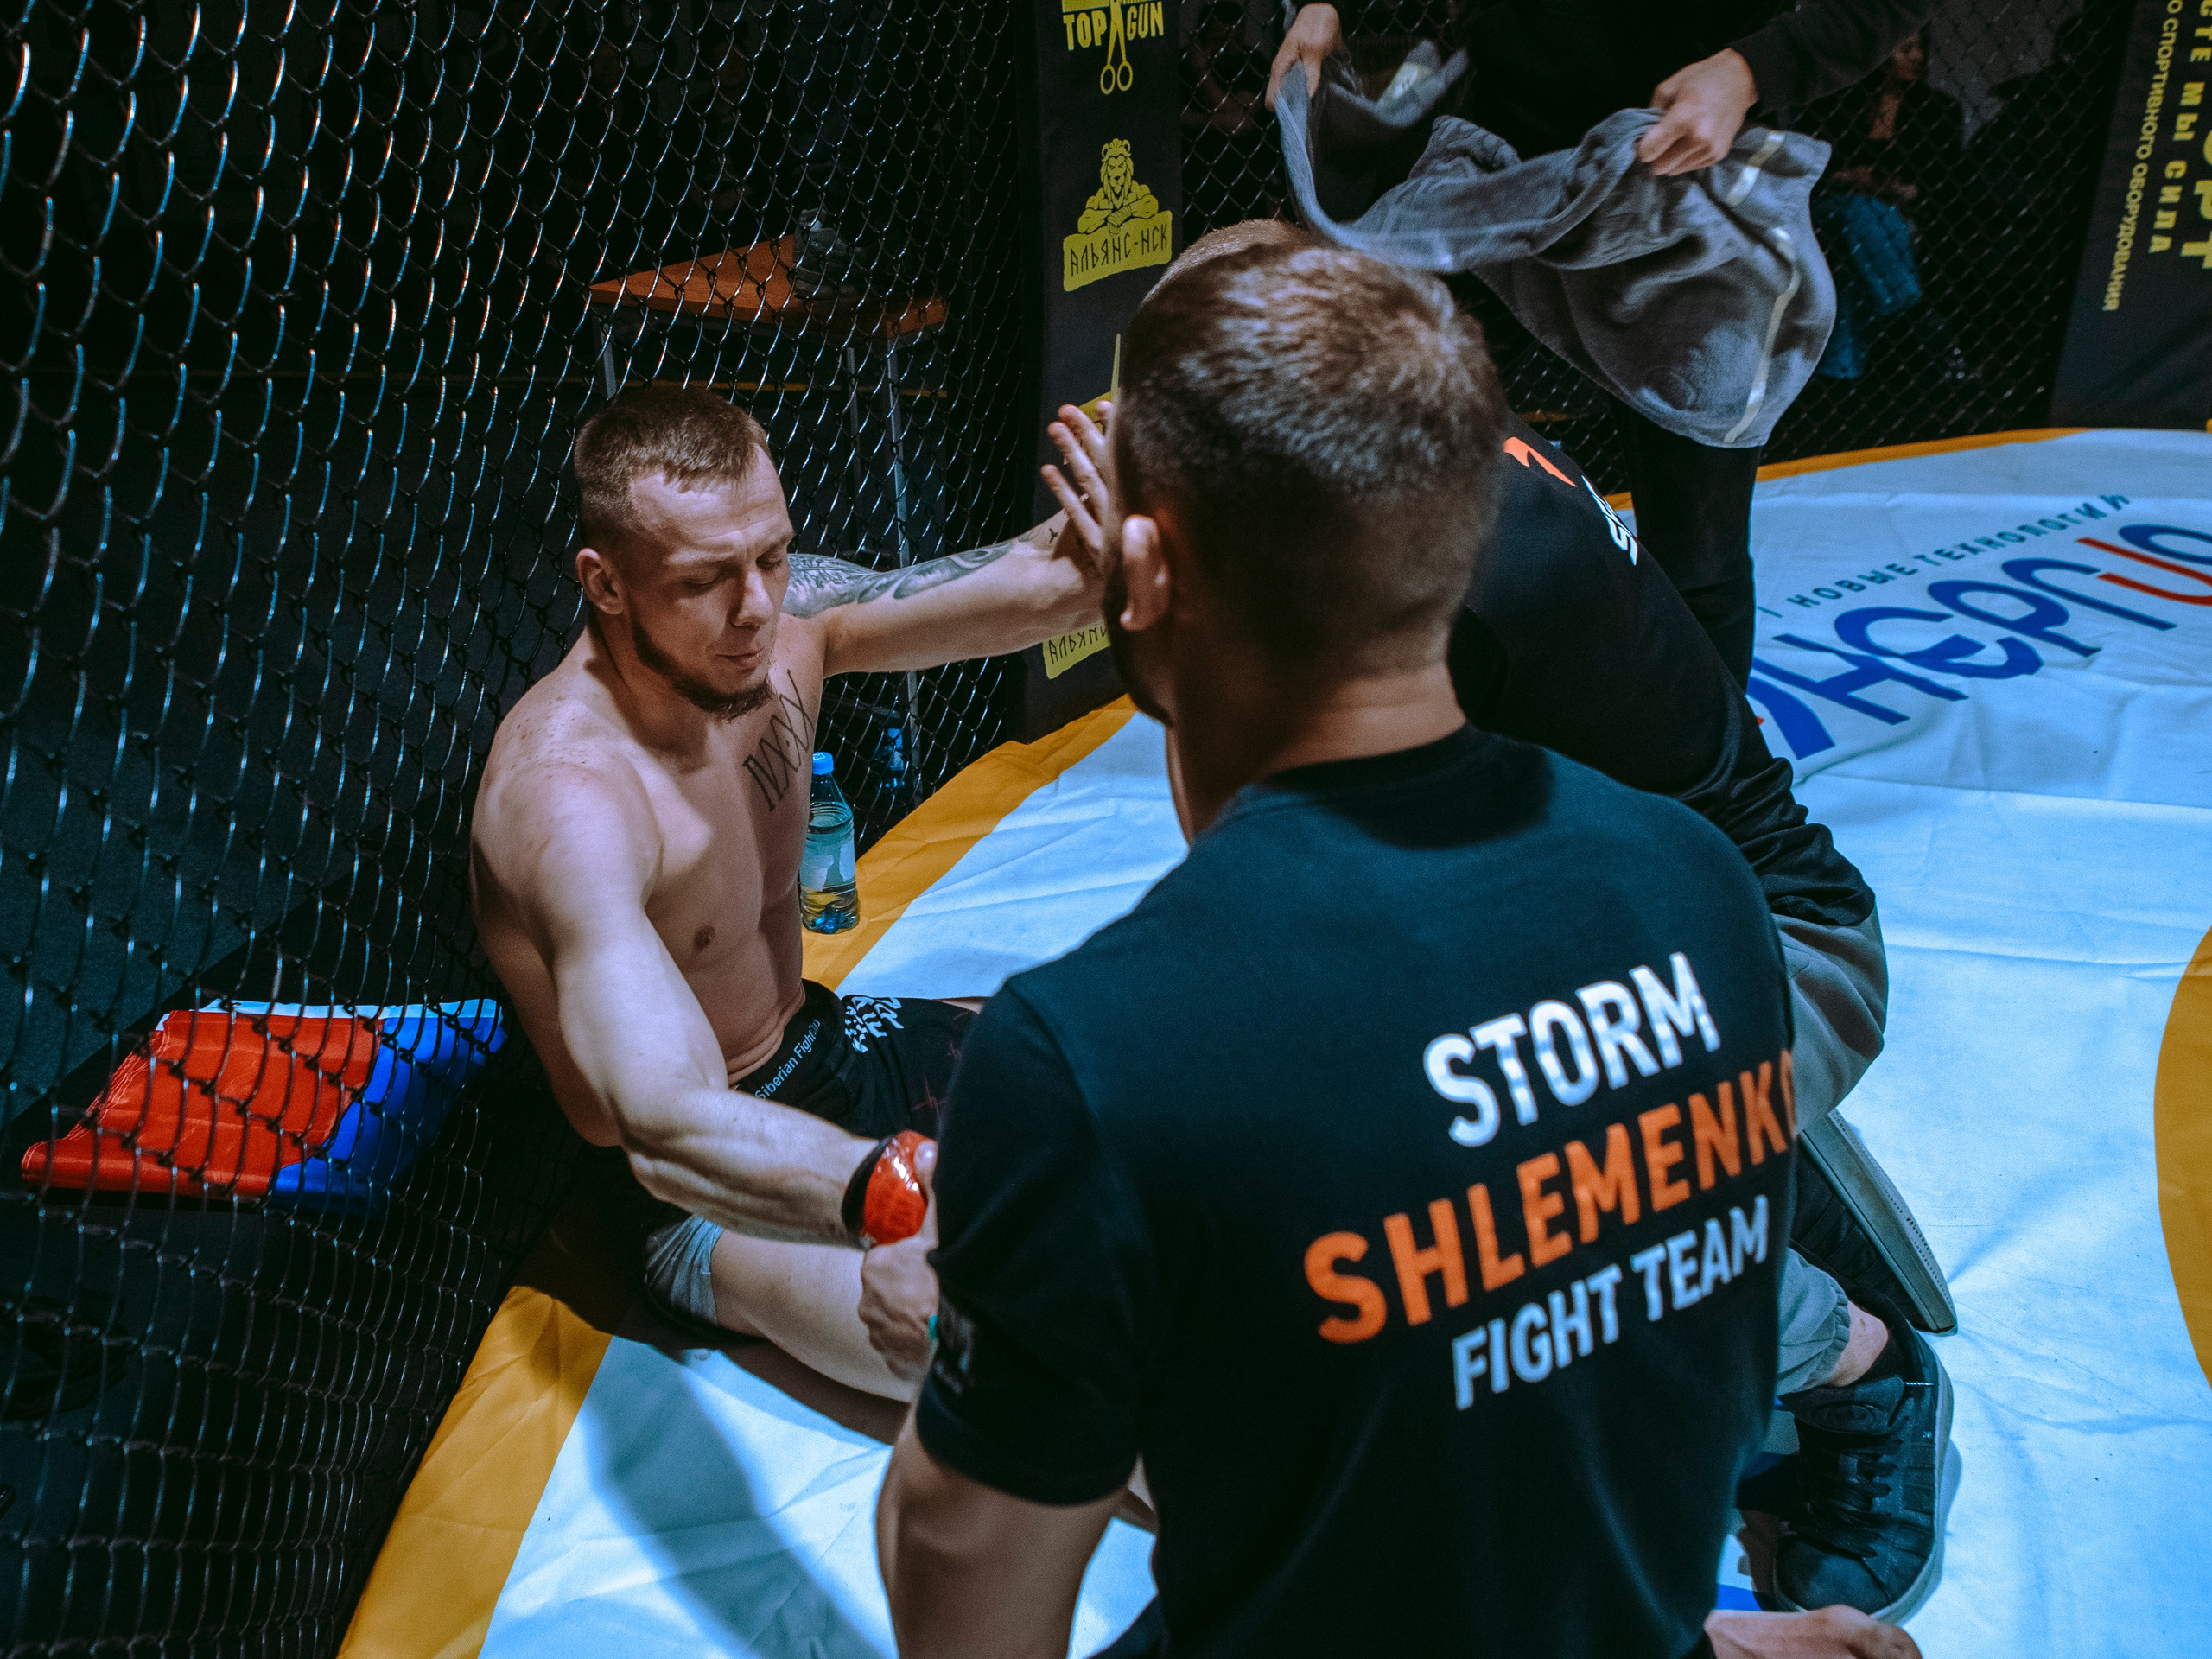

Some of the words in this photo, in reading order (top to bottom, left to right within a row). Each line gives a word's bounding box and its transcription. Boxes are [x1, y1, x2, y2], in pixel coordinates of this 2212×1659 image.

[1063, 10, 1107, 51] TOP
[1126, 1, 1164, 41] GUN
[2135, 17, 2179, 160] СПОРТИВНОГО
[2173, 81, 2204, 141] МЫ
[1070, 222, 1168, 276] АЛЬЯНС-НСК
[2102, 162, 2149, 311] ОБОРУДОВАНИЯ
[2148, 160, 2187, 253] СИЛА
[1786, 563, 1918, 609] НОВЫЕ
[1913, 494, 2131, 567] ТЕХНОЛОГИИ
[754, 1057, 799, 1101] Siberian
[1422, 950, 1720, 1147] STORM
[1451, 1263, 1623, 1412] FIGHT
[1630, 1194, 1769, 1322] TEAM
